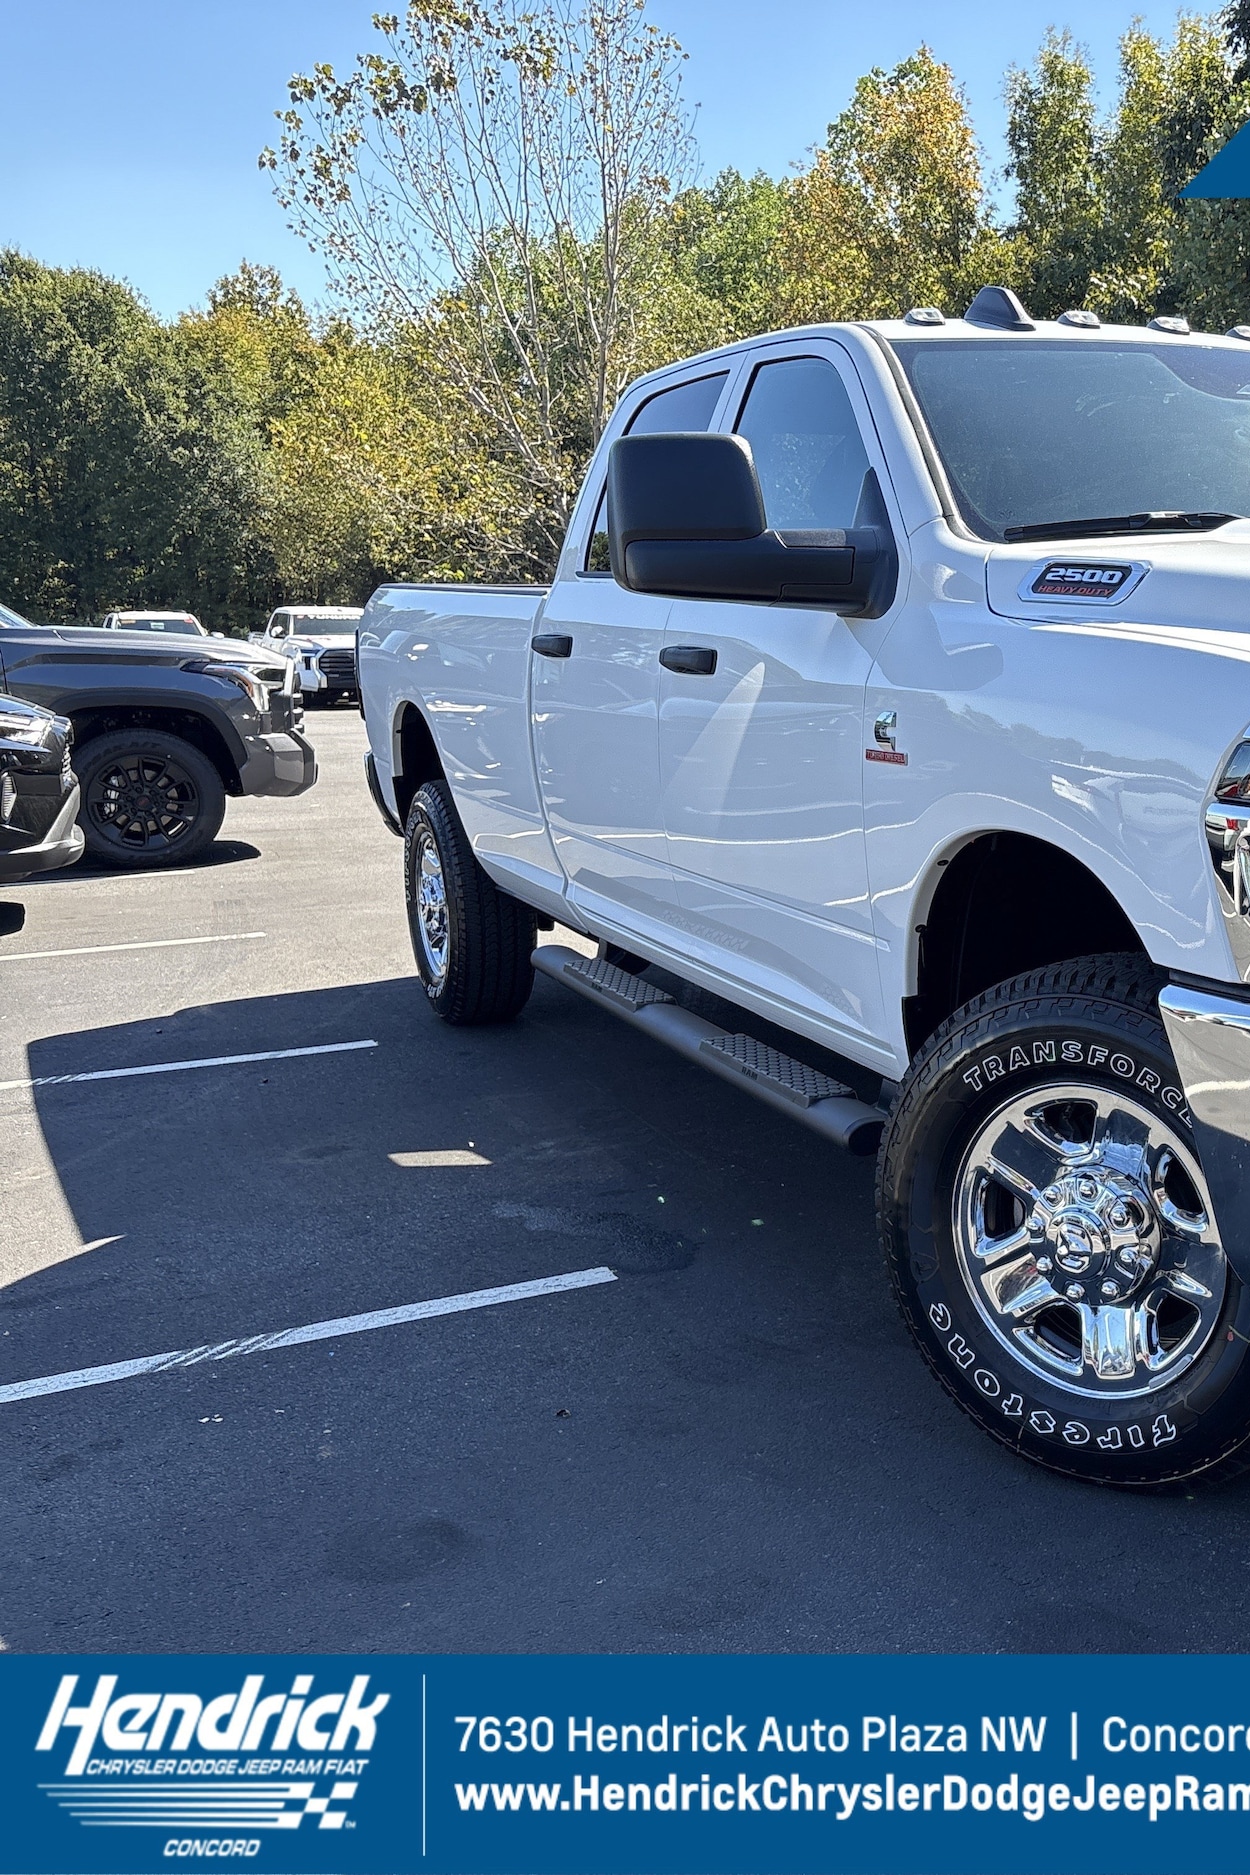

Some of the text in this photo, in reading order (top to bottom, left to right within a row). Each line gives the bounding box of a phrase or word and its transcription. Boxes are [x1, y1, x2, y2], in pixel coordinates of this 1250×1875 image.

[1045, 567, 1123, 584] 2500
[1037, 585, 1113, 596] HEAVY DUTY
